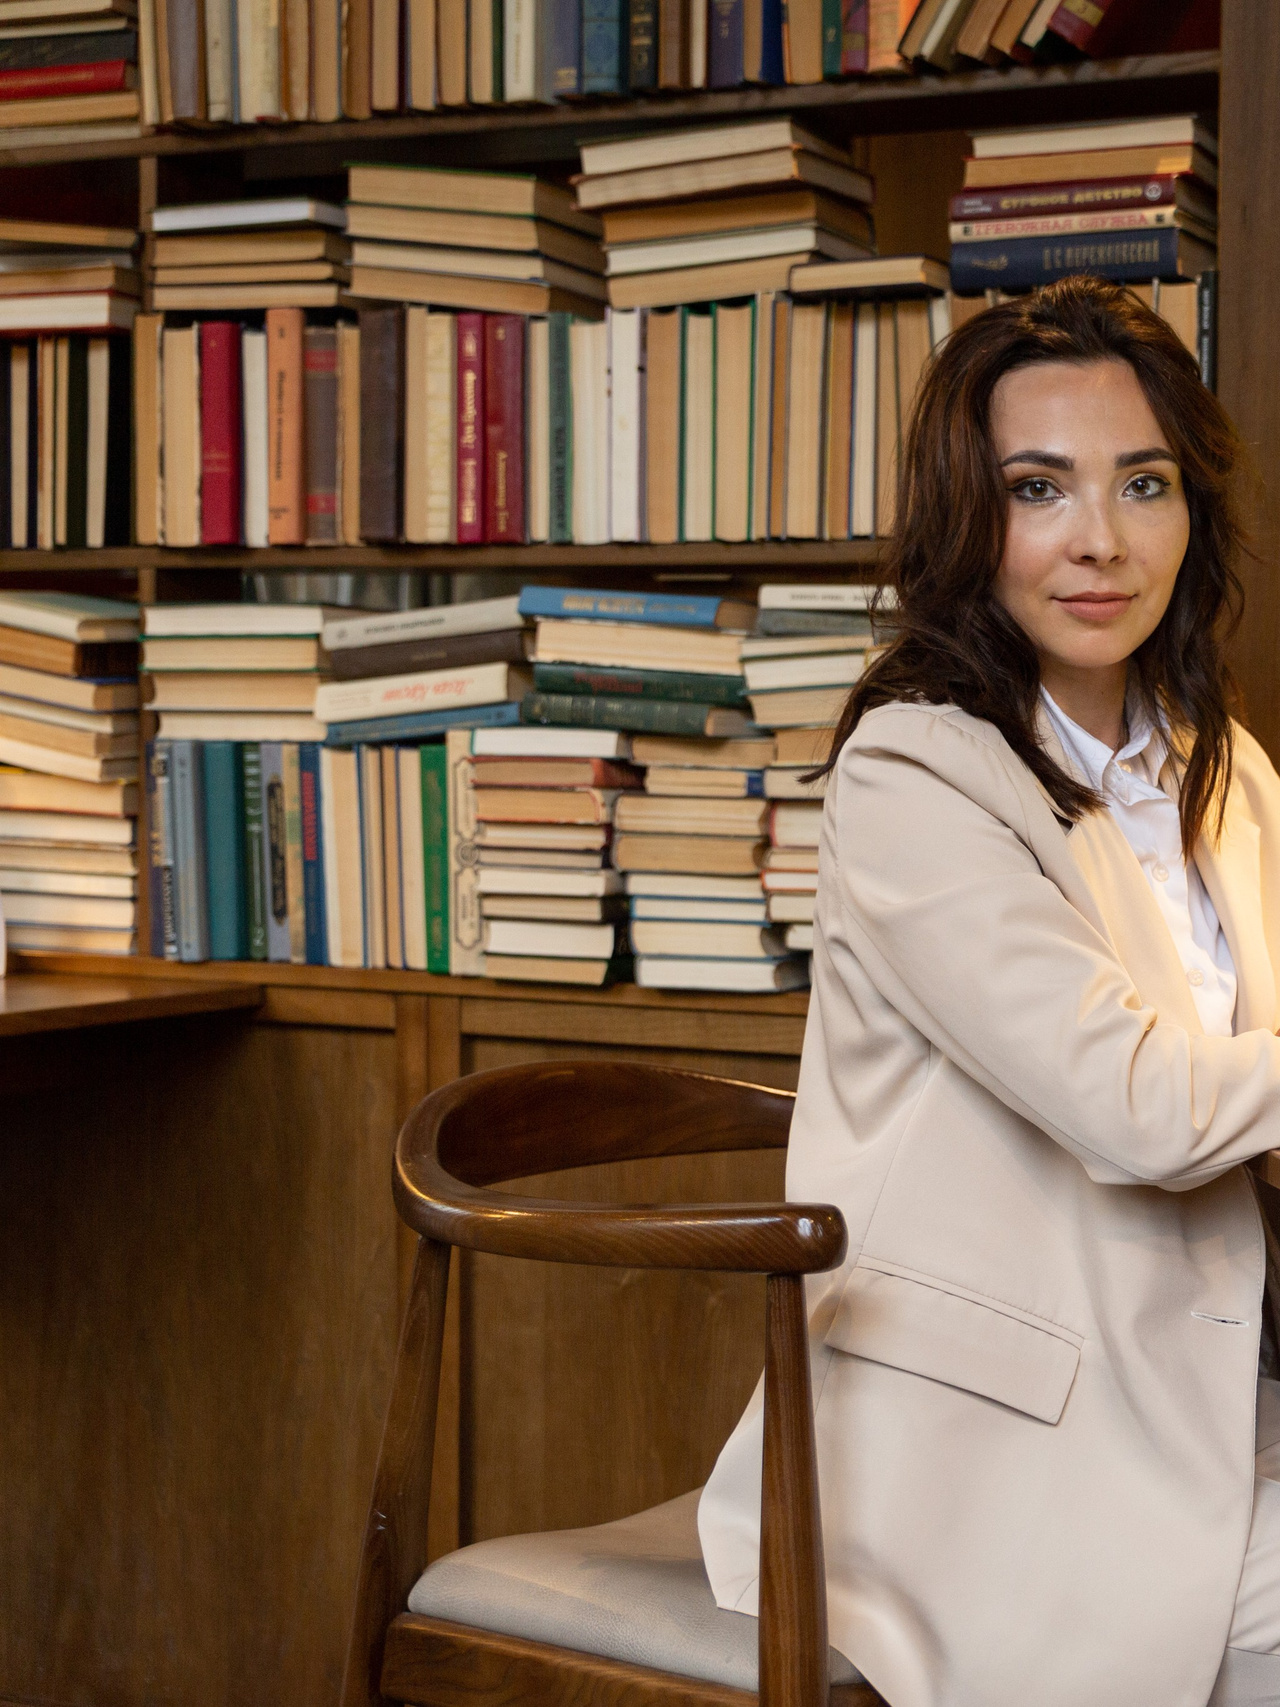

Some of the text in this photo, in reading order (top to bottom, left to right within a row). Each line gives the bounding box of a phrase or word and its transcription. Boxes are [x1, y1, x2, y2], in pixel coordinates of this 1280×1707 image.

[1072, 187, 1142, 205] ДЕТСТВО
[972, 213, 1148, 238] ТРЕВОЖНАЯ СЛУЖБА
